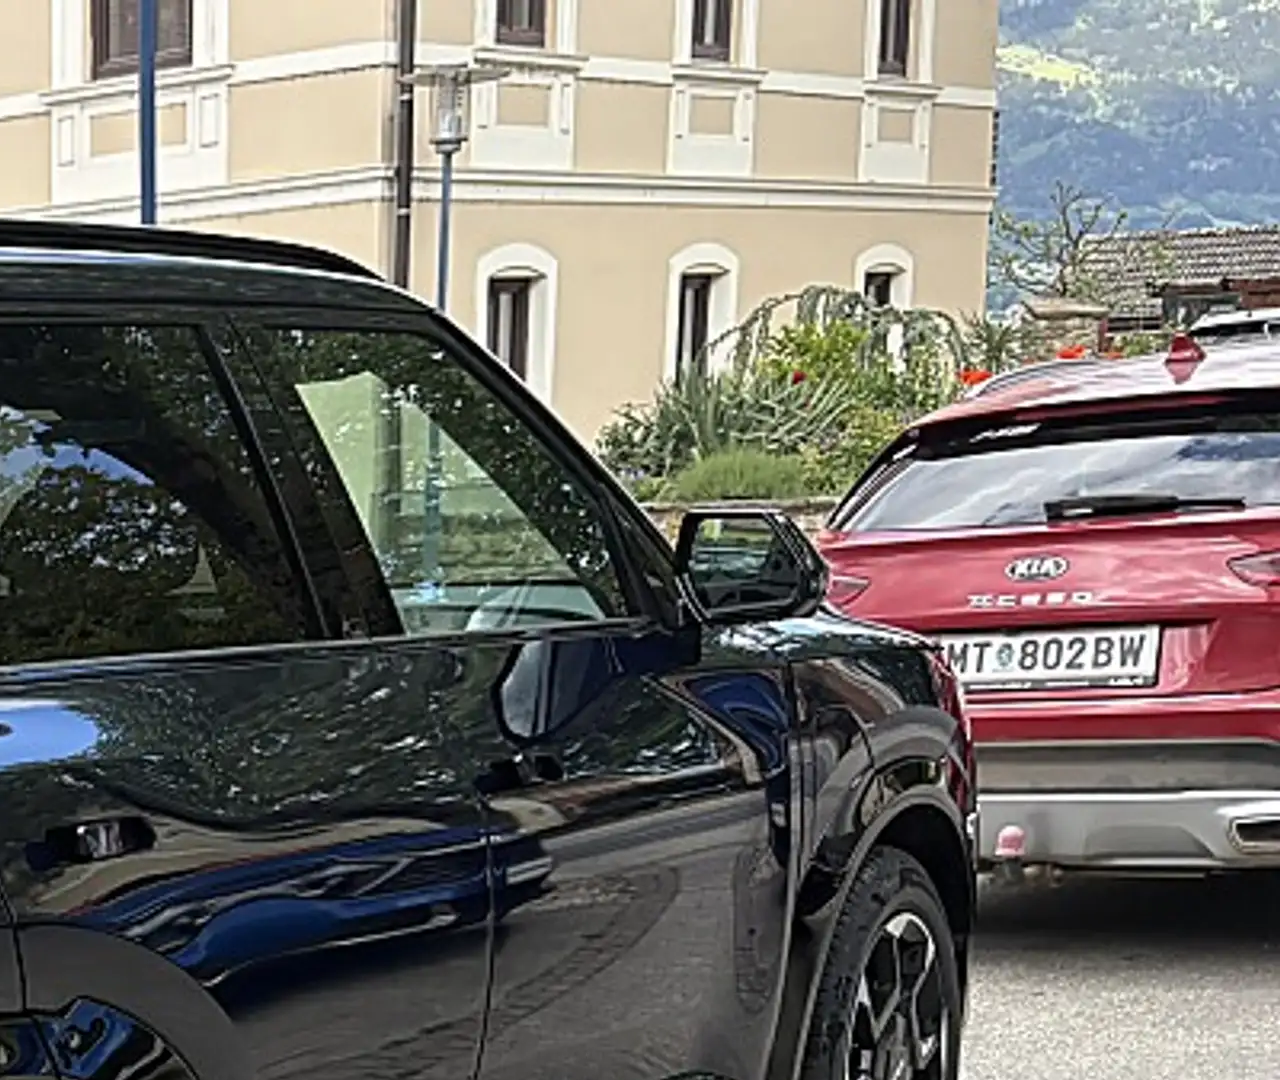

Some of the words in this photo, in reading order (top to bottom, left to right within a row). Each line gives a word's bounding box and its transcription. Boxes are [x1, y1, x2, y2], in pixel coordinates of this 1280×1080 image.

[1013, 558, 1059, 578] KIA
[947, 642, 993, 673] MT
[1018, 634, 1146, 671] 802BW
